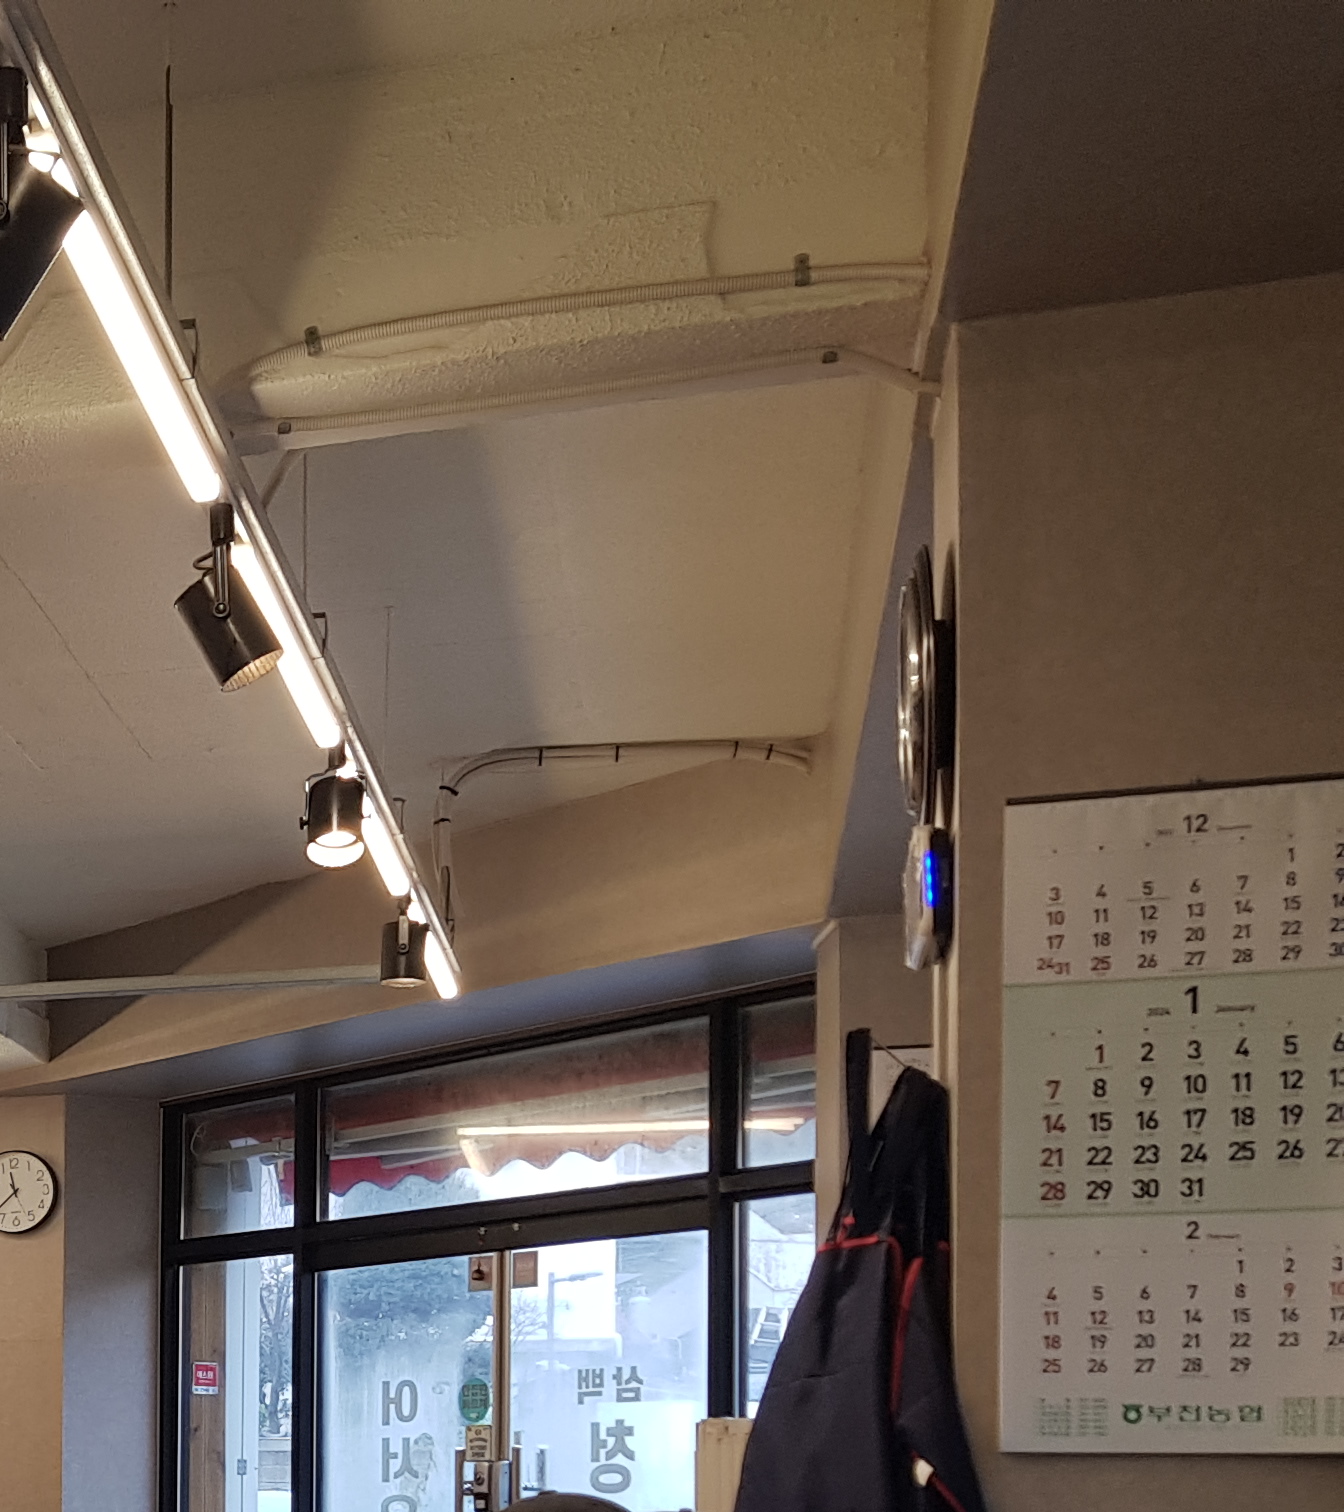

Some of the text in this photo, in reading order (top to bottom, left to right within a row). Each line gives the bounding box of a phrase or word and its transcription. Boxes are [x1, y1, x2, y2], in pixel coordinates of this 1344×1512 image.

[1184, 814, 1209, 833] 12
[1048, 896, 1301, 926] 10 11 12 13 14 15
[1184, 985, 1198, 1014] 1
[1095, 1032, 1344, 1063] 1 2 3 4 5 6
[1046, 1070, 1303, 1100] 7 8 9 10 11 12
[1043, 1104, 1303, 1133] 14 15 16 17 18 19
[1040, 1140, 1304, 1168] 21 22 23 24 25 26
[9, 1158, 19, 1169] 12
[27, 1161, 30, 1171] 1
[37, 1170, 44, 1181] 2
[42, 1184, 49, 1195] 3
[1041, 1178, 1204, 1201] 28 29 30 31
[38, 1199, 44, 1208] 4
[0, 1213, 6, 1224] 7
[13, 1216, 20, 1226] 6
[28, 1210, 35, 1221] 5
[1186, 1221, 1200, 1239] 2
[1044, 1308, 1299, 1325] 11 12 13 14 15 16
